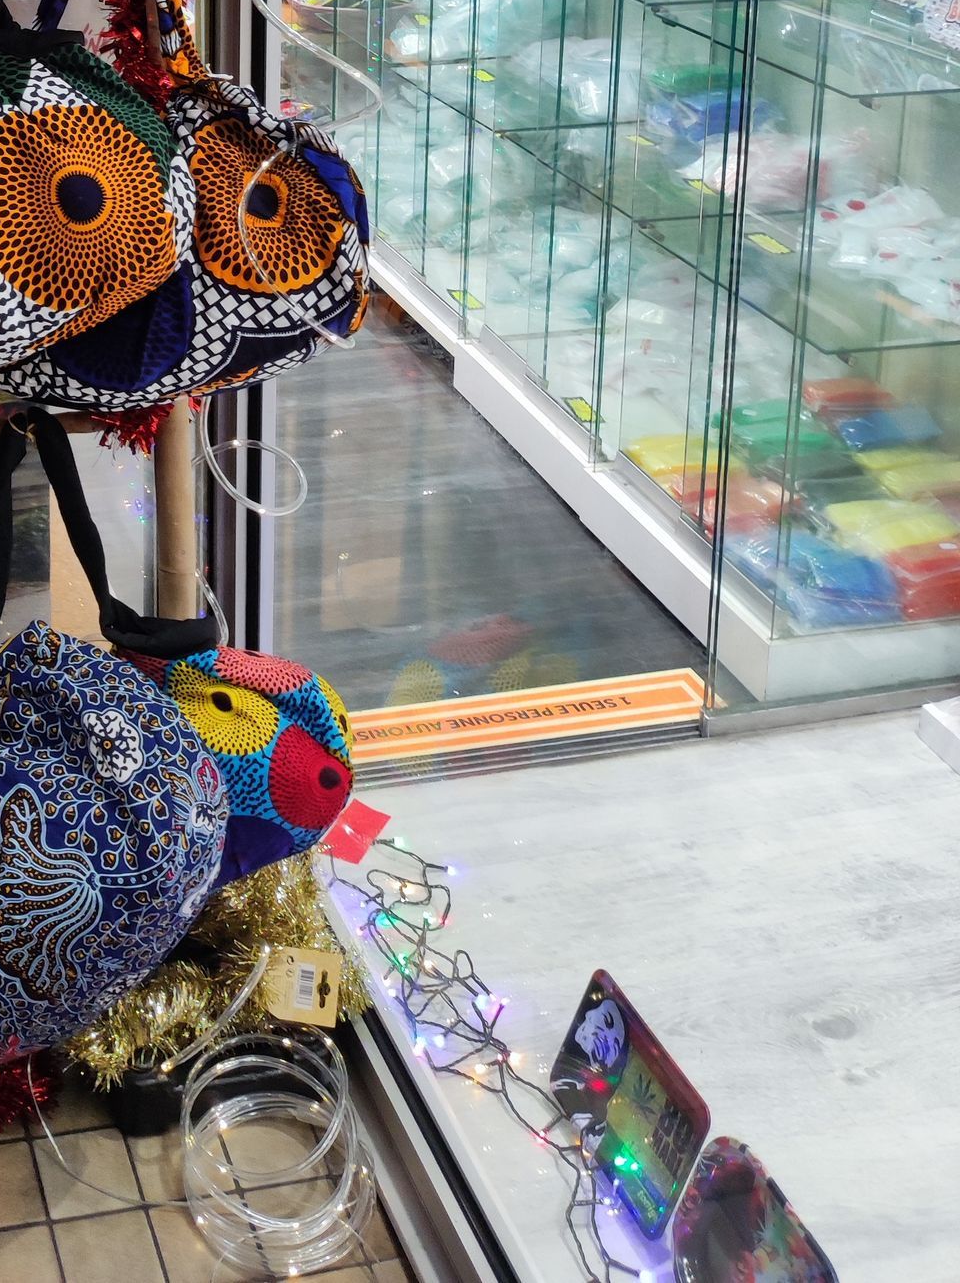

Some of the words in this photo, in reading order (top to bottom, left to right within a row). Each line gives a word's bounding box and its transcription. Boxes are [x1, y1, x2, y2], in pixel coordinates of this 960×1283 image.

[556, 698, 618, 715] SEULE
[618, 696, 632, 705] 1
[446, 707, 554, 729] PERSONNE
